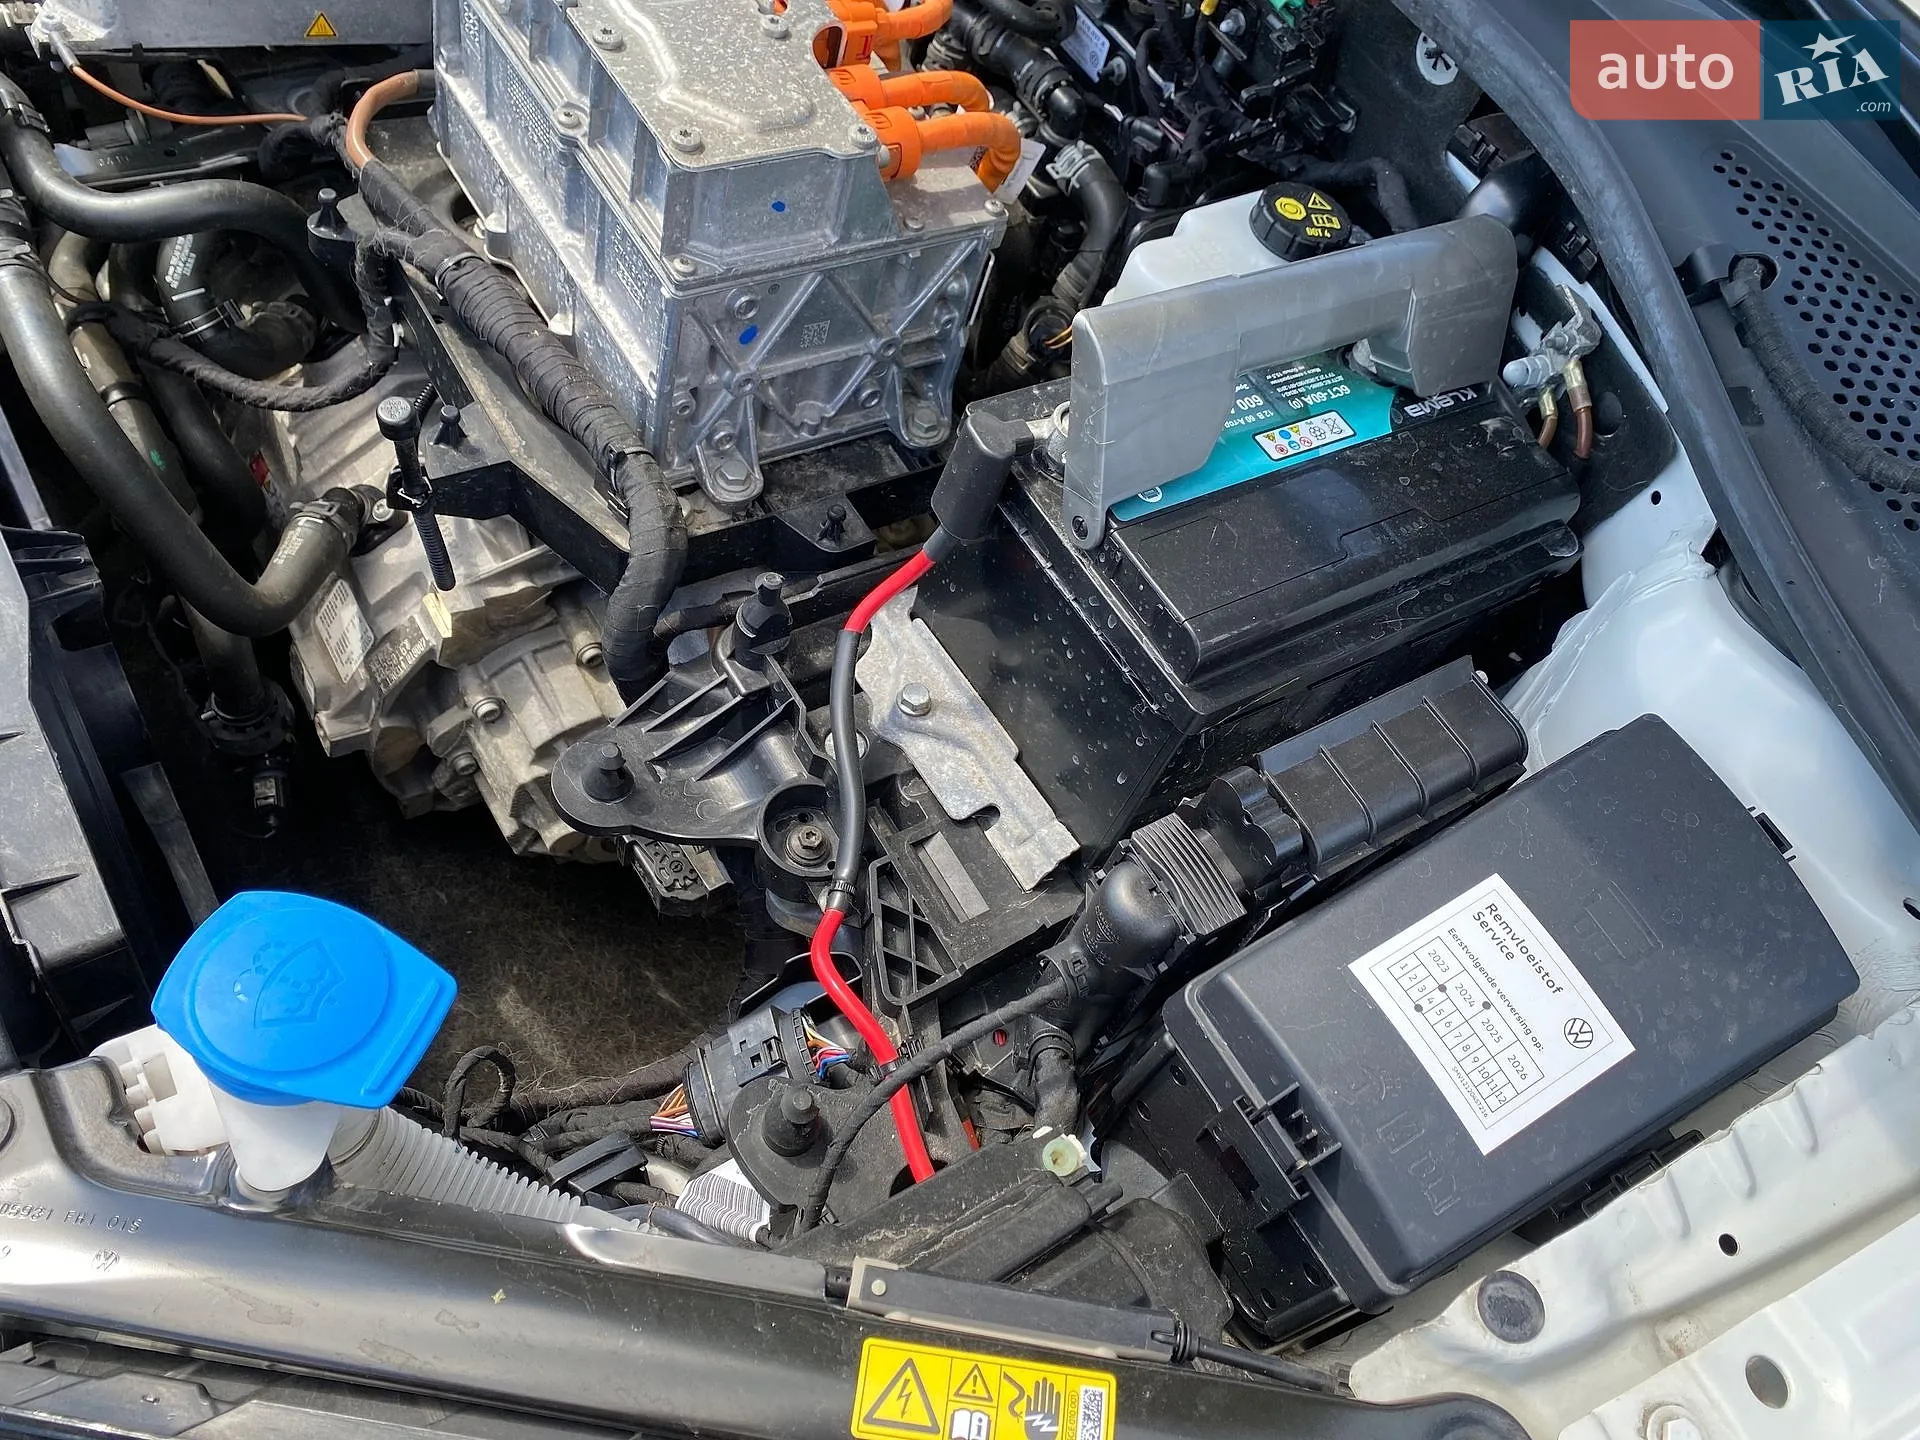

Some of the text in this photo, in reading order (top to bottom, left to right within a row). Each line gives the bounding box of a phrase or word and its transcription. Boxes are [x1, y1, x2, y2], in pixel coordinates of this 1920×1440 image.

[1305, 226, 1332, 238] DOT 4
[1236, 394, 1264, 411] 600
[1245, 414, 1256, 424] 60
[1263, 409, 1274, 418] 12
[1472, 911, 1515, 961] Service
[1485, 903, 1563, 994] Remvloeistof
[1448, 927, 1544, 1051] Eerstvolgende verversing op:
[1408, 973, 1418, 982] 2
[1418, 984, 1426, 993] 3
[1435, 1008, 1445, 1016] 5
[1444, 1020, 1453, 1028] 6
[1462, 1044, 1471, 1052] 8
[1471, 1056, 1480, 1064] 9
[1478, 1066, 1490, 1079] 10
[1486, 1079, 1498, 1091] 11
[1494, 1090, 1507, 1104] 12
[1428, 949, 1528, 1080] 2023 2024 2025 2026
